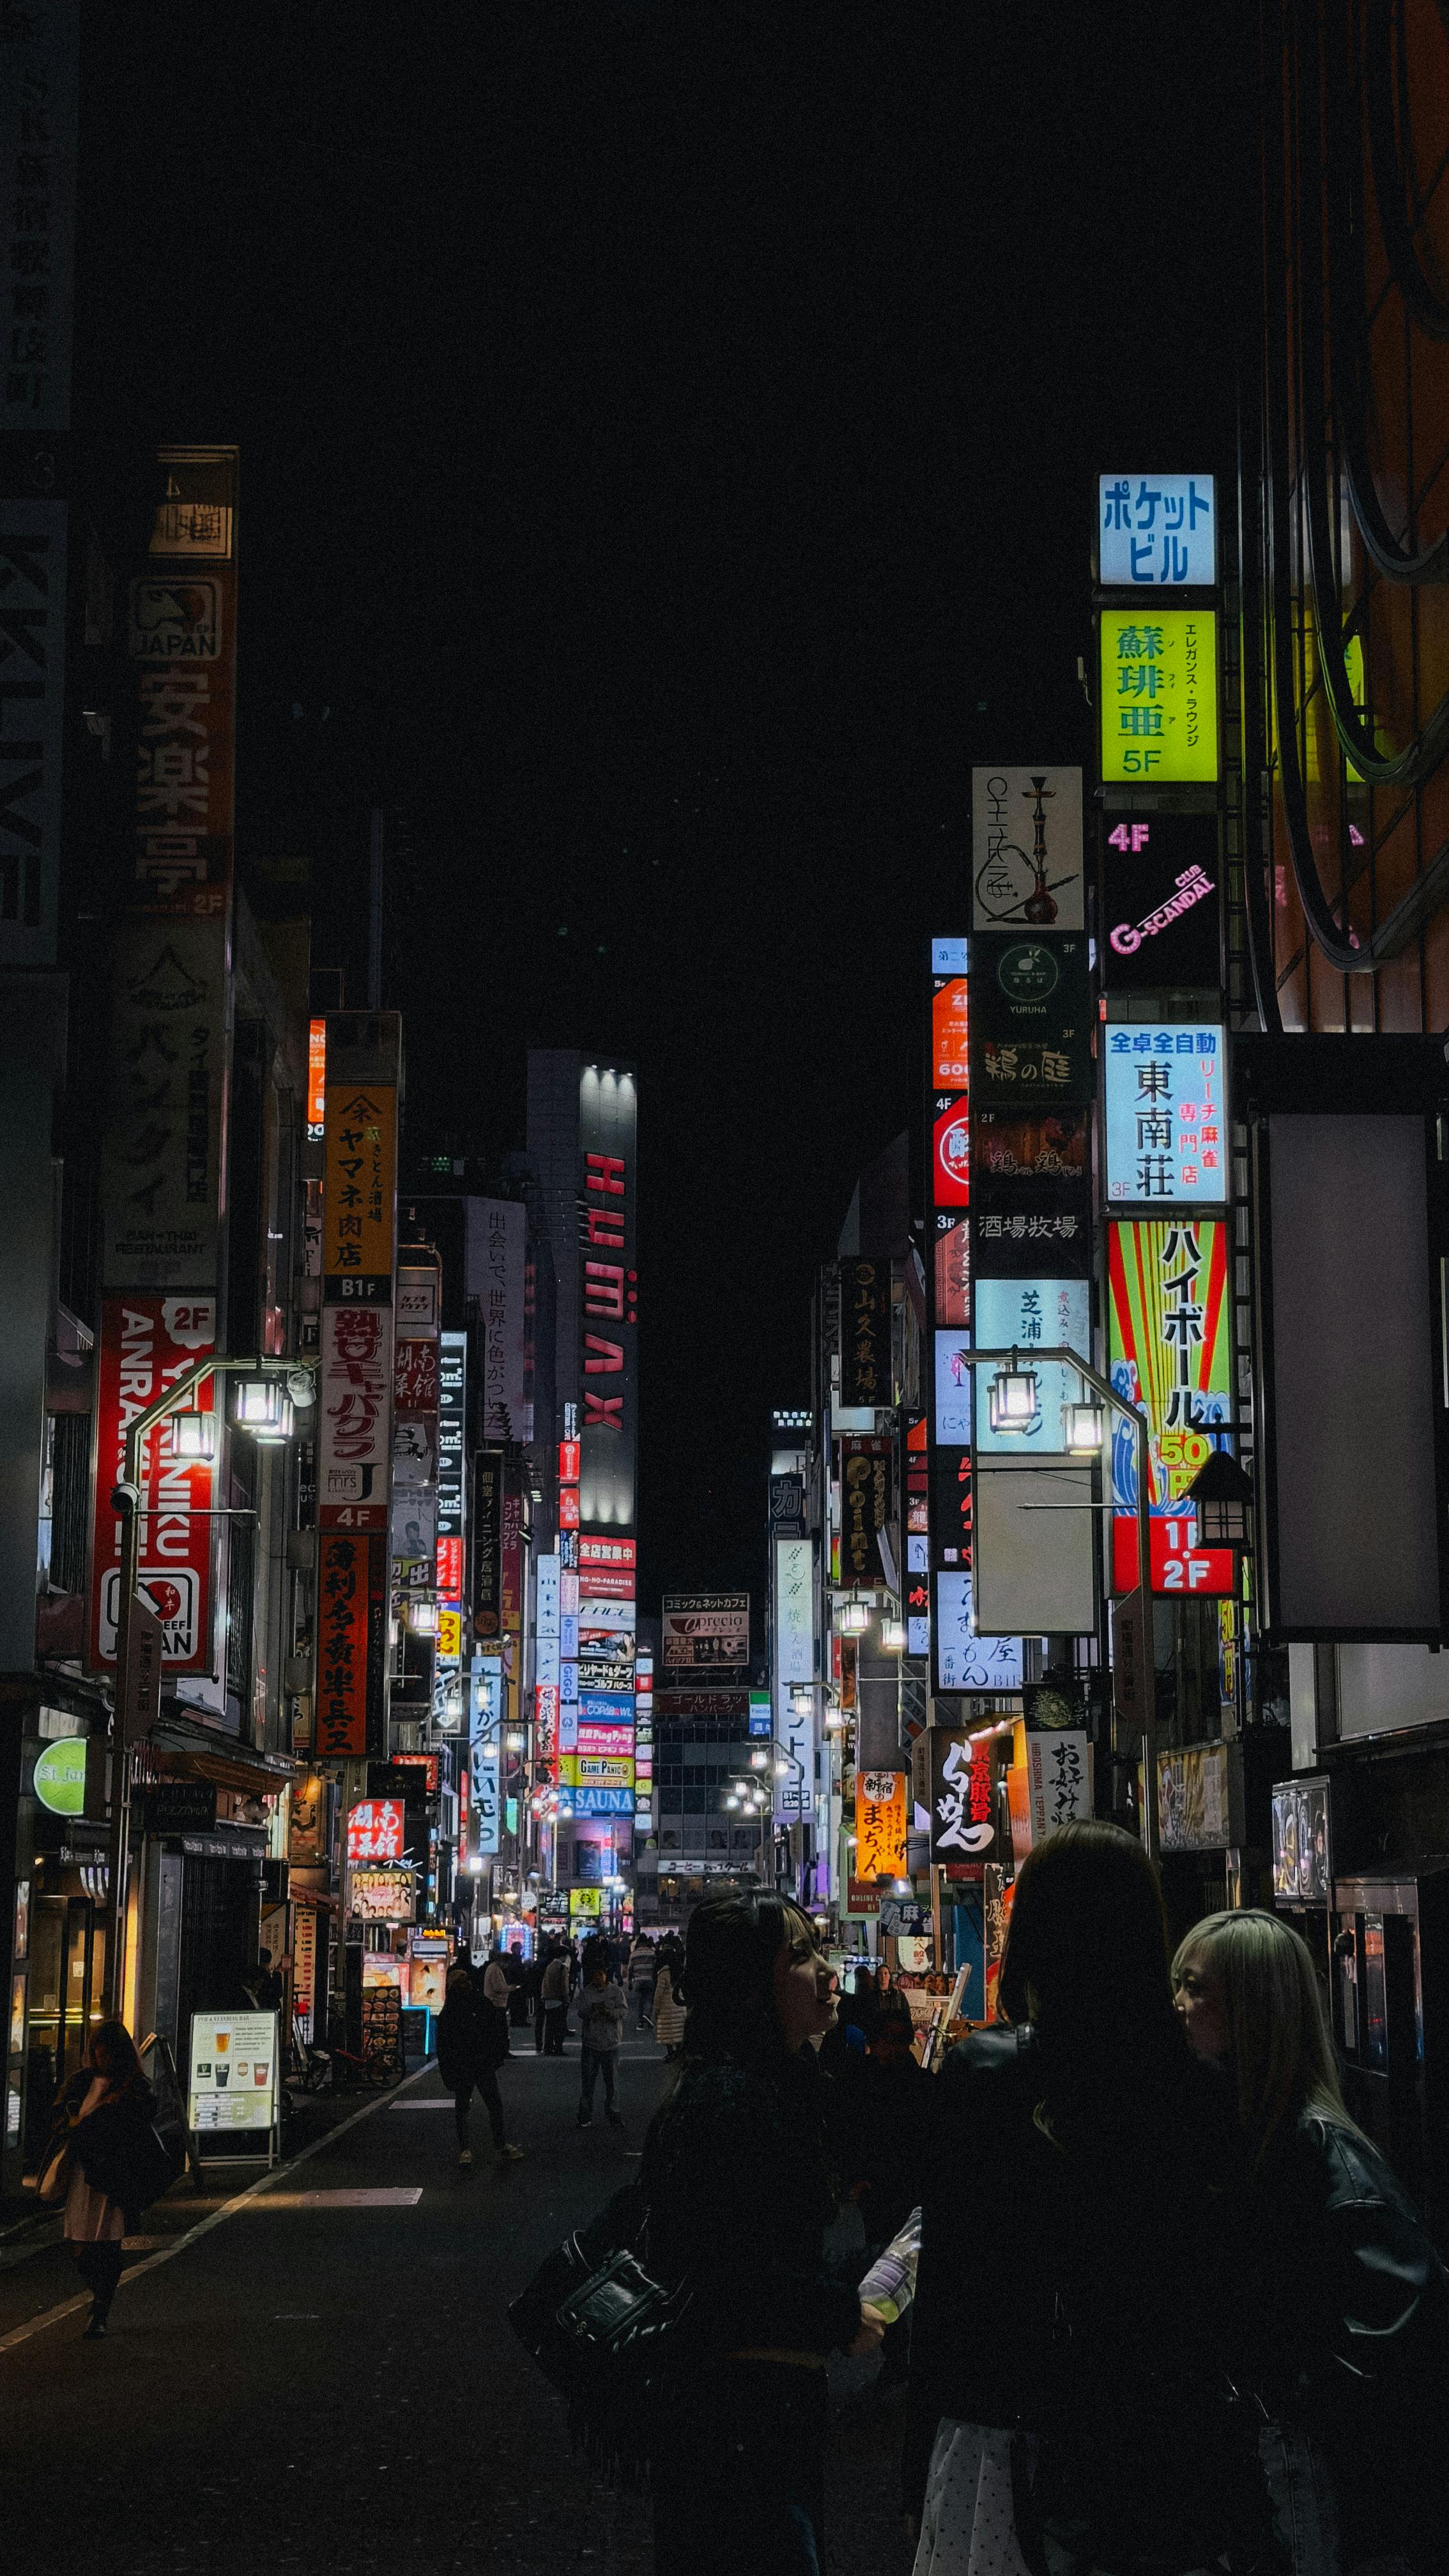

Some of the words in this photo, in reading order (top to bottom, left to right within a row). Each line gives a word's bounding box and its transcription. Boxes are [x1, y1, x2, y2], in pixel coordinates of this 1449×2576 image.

[1104, 480, 1209, 532] ポケット
[1130, 534, 1188, 583] ビル
[1185, 624, 1199, 747] エレガンス・ラウンジ
[1123, 749, 1162, 774] 5F
[135, 671, 212, 894] 安楽亭
[1108, 824, 1149, 852] 4F
[1174, 864, 1202, 889] CLUB
[194, 894, 223, 914] 2F
[1063, 944, 1076, 953] 3F
[1009, 1006, 1047, 1014] YURUHA
[1062, 1029, 1075, 1039] 3F
[1110, 1032, 1216, 1055] 全卓全自動
[936, 1098, 951, 1110] 4F
[1200, 1059, 1218, 1169] リーチ麻雀
[981, 1114, 995, 1123] 2F
[1134, 1060, 1175, 1198] 東南荘
[1179, 1103, 1199, 1185] 専門店
[337, 1129, 363, 1267] ヤマネ肉店
[1112, 1182, 1131, 1197] 3F
[937, 1215, 955, 1229] 3F
[979, 1215, 1078, 1238] 酒場牧場
[342, 1279, 375, 1296] B1F
[173, 1307, 210, 1331] 2F
[1160, 1228, 1206, 1429] ハイボール
[850, 1439, 883, 1452] 麻雀
[1160, 1435, 1210, 1468] 50
[337, 1508, 370, 1526] 4F
[579, 1542, 632, 1561] 全店営業中
[1163, 1561, 1211, 1589] 2F
[666, 1598, 746, 1609] コミック&ネットカフェ
[942, 1647, 956, 1687] 一番街
[672, 1693, 749, 1705] ゴールドラッ
[1031, 1743, 1044, 1790] HIROSHIMA
[576, 1790, 634, 1809] SAUNA
[864, 1804, 883, 1873] まっちゃん
